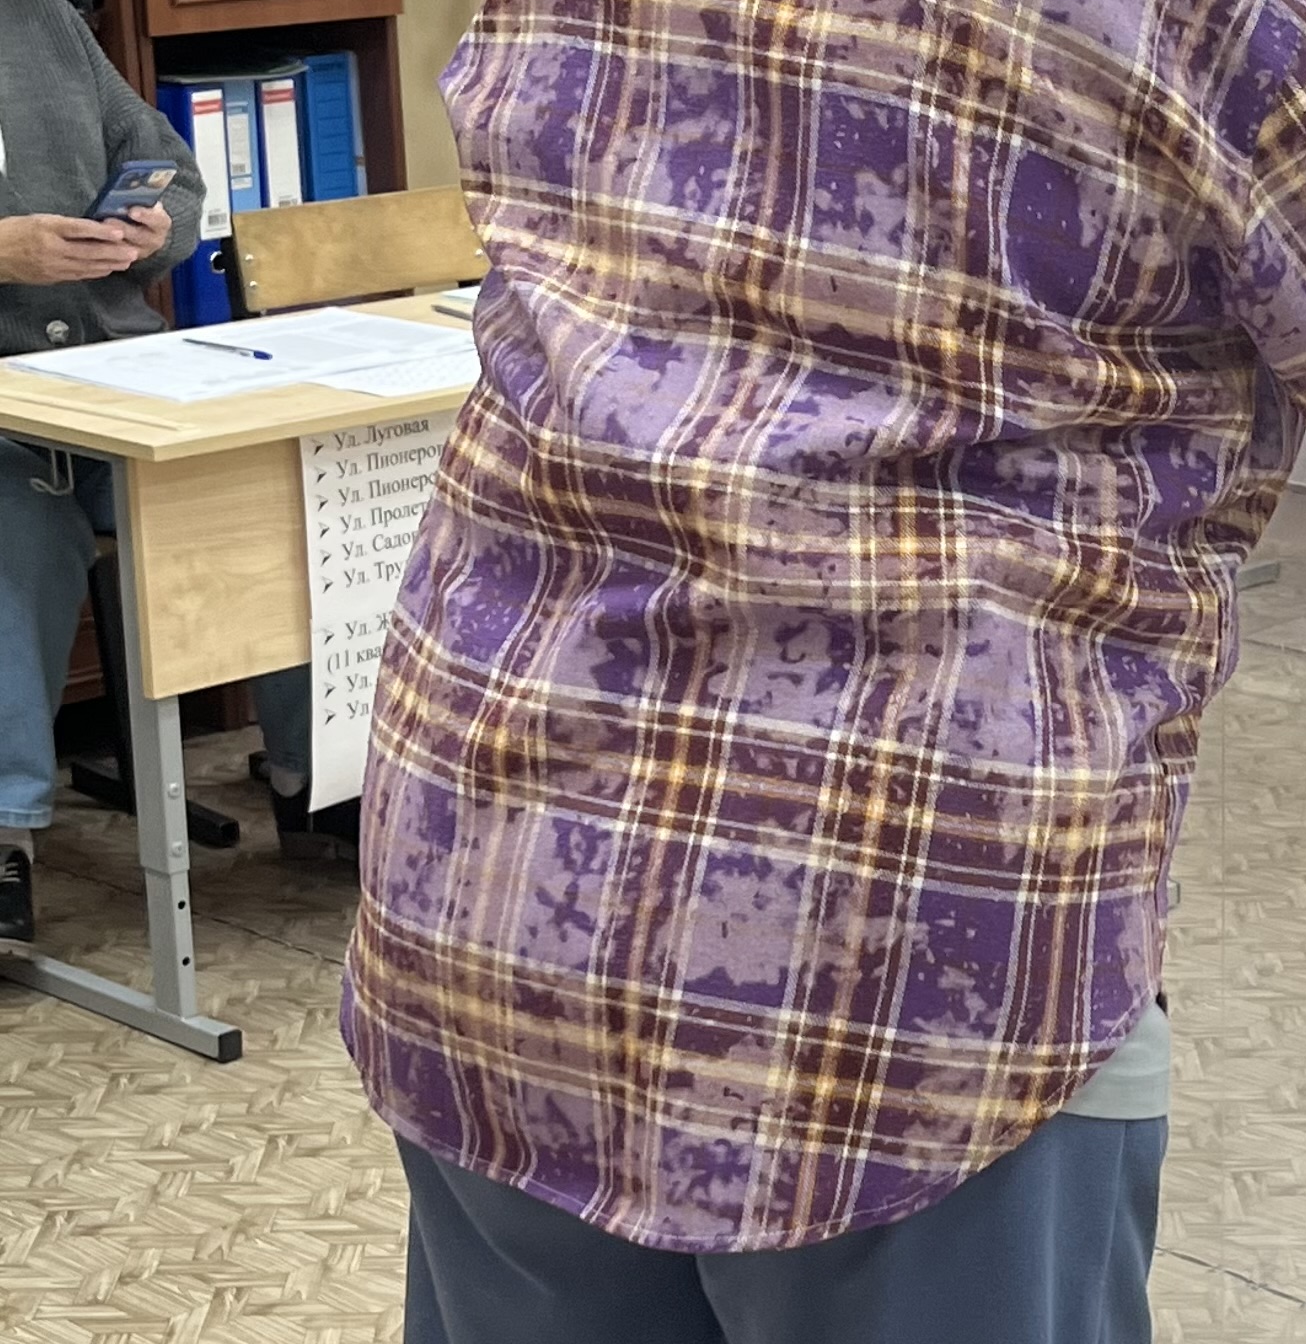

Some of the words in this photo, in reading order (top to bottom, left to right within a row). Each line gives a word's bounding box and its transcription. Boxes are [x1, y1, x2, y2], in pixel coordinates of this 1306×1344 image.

[333, 431, 362, 452] Ул.
[363, 418, 431, 447] Луговая
[335, 458, 363, 479] Ул.
[337, 485, 366, 507] Ул.
[340, 514, 367, 534] Ул.
[341, 541, 368, 561] Ул.
[343, 568, 371, 589] Ул.
[345, 620, 372, 641] Ул.
[346, 672, 373, 693] Ул.
